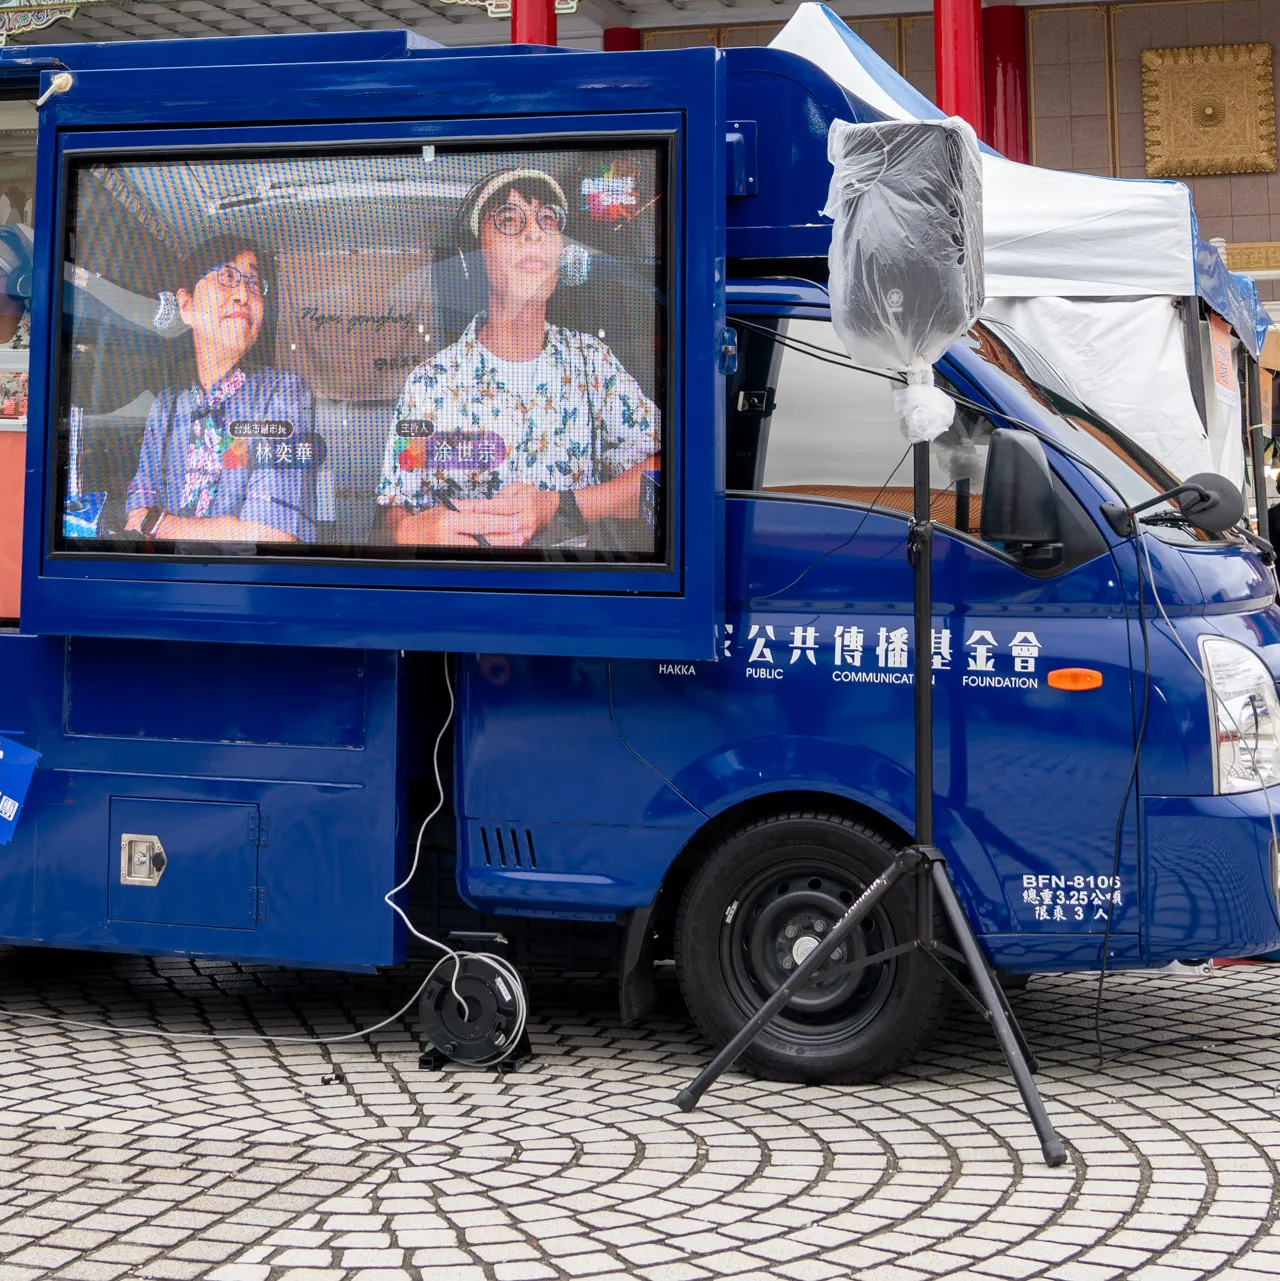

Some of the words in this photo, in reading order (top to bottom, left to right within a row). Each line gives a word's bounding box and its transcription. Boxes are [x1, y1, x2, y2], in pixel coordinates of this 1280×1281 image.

[255, 442, 312, 463] 林奕華
[433, 441, 497, 463] 涂世宗
[659, 663, 696, 676] HAKKA
[746, 667, 784, 679] PUBLIC
[962, 675, 1038, 689] FOUNDATION
[1022, 875, 1121, 889] BFN-8106
